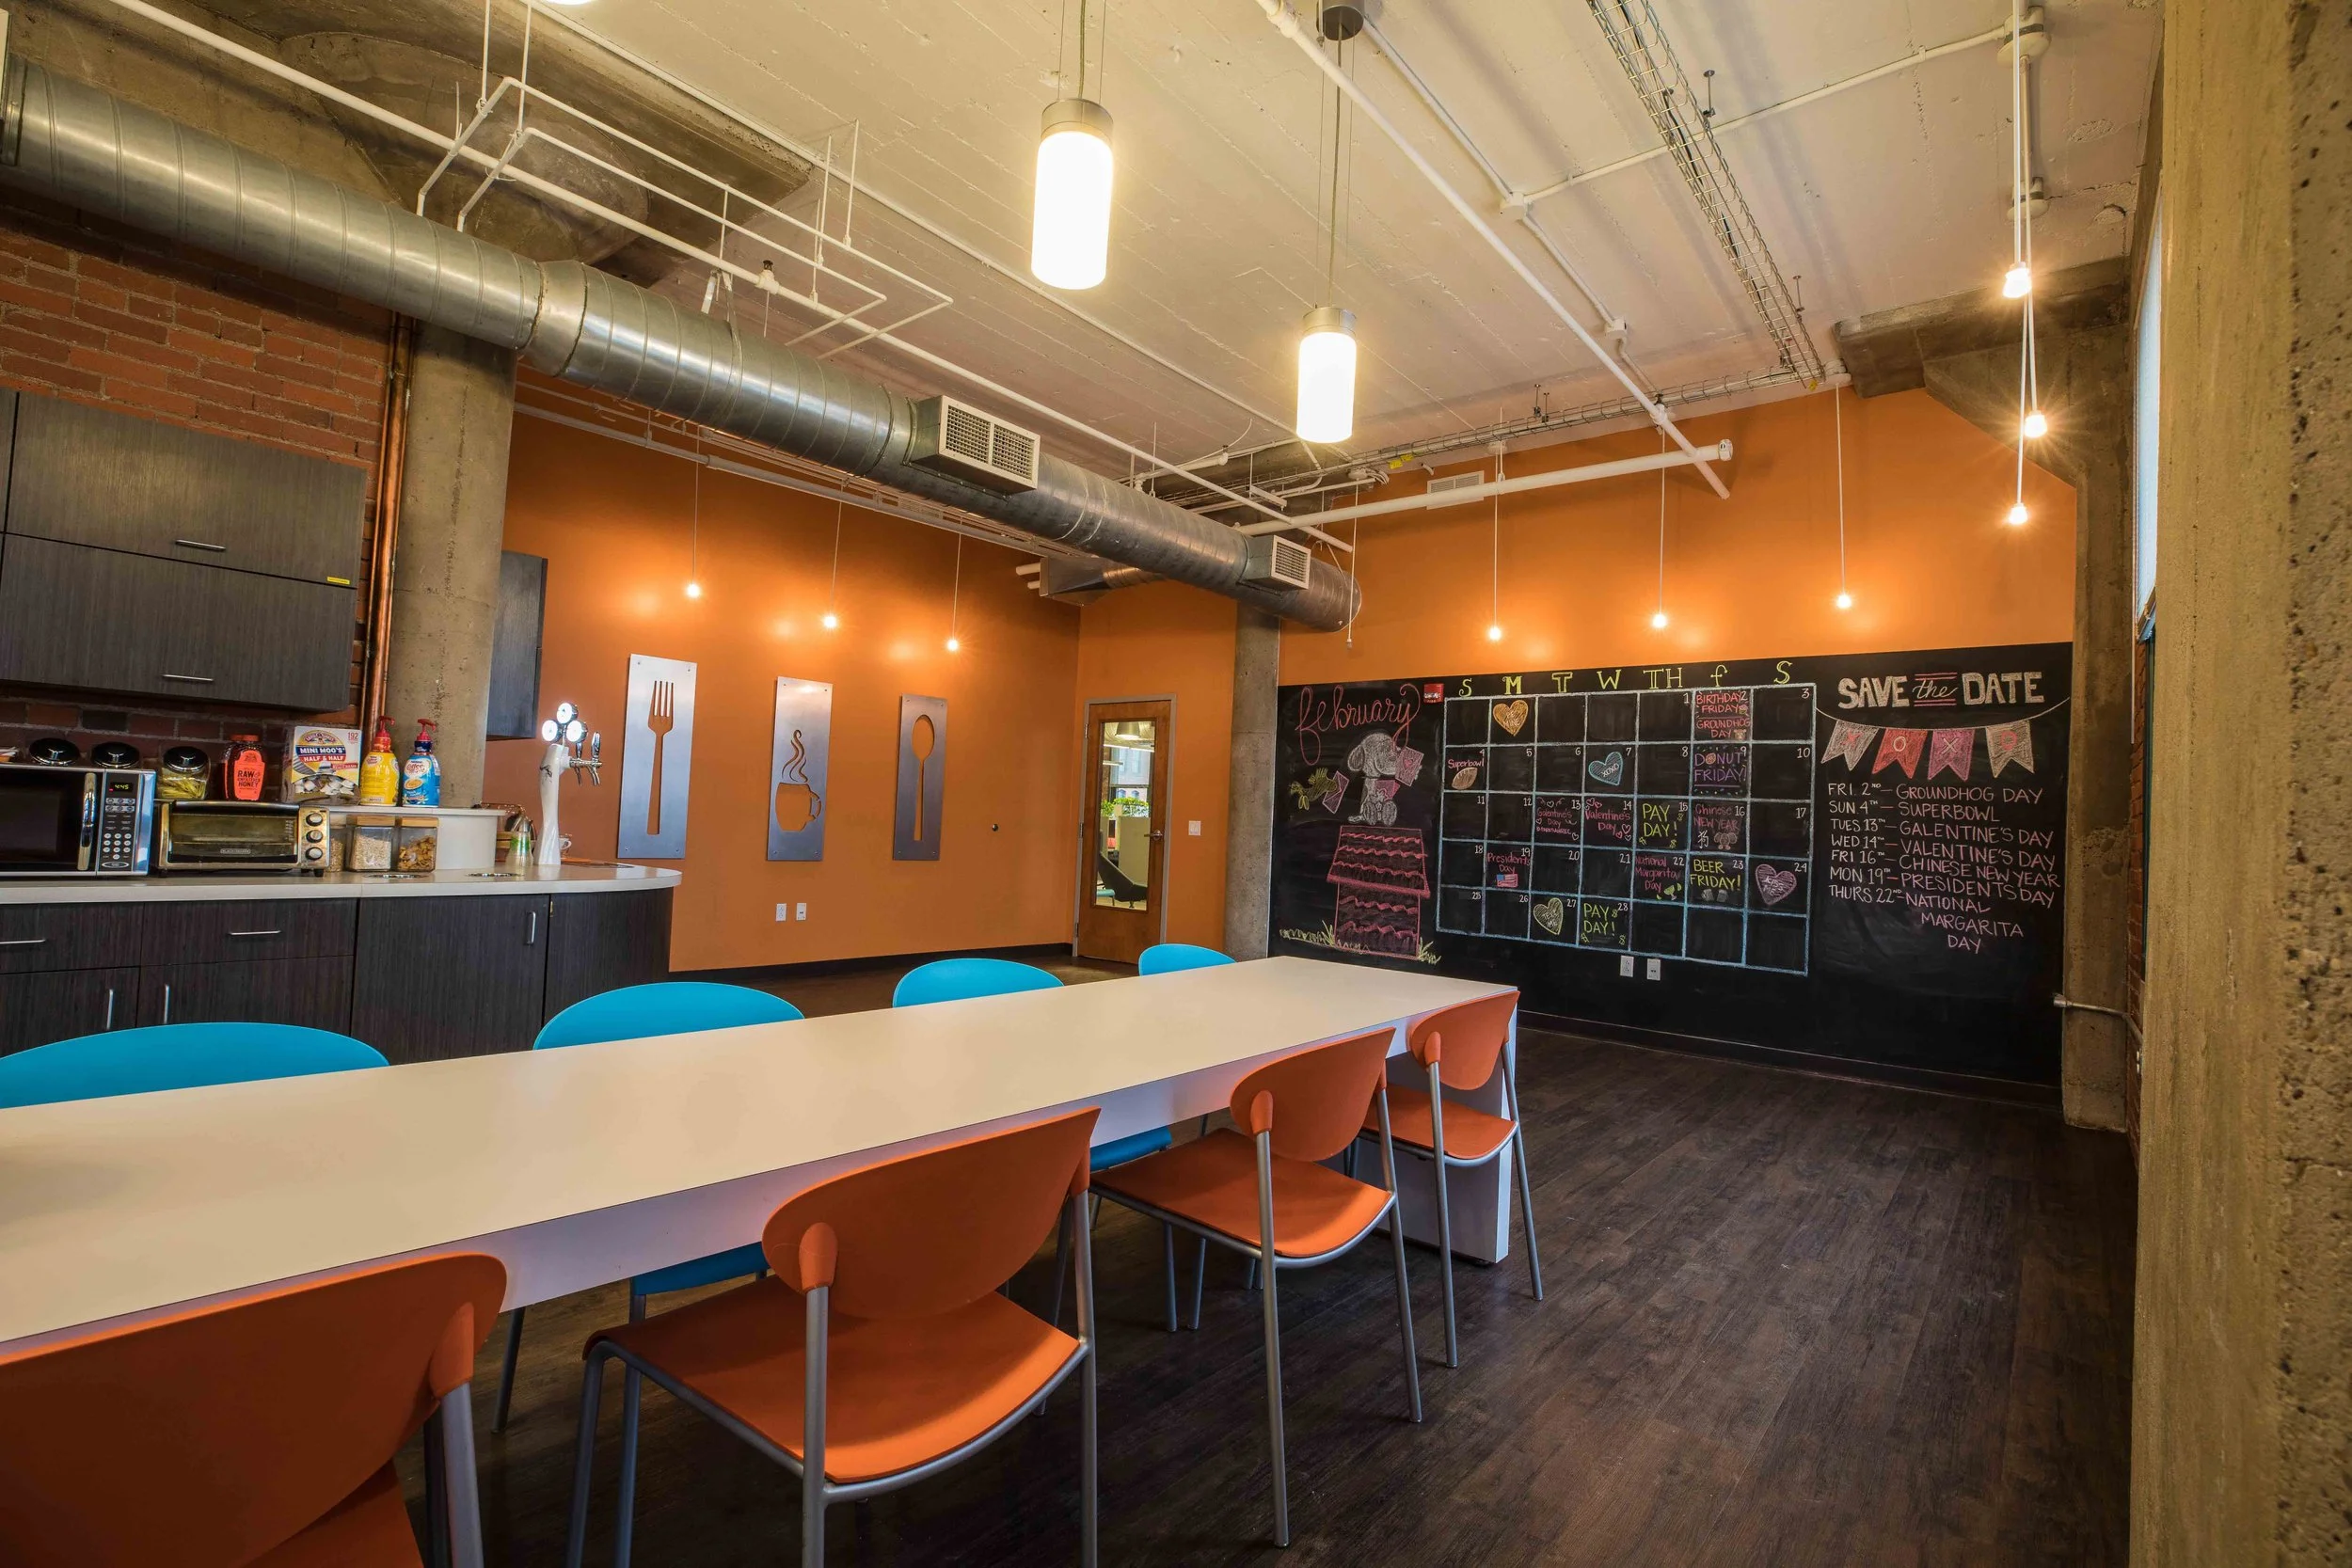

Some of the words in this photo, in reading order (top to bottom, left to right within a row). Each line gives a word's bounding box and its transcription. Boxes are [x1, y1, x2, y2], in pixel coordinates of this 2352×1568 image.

[1459, 678, 1472, 697] S
[1502, 675, 1523, 695] M
[1552, 672, 1573, 693] T
[1597, 669, 1622, 690] W
[1773, 660, 1793, 685] S
[1740, 690, 1747, 702] 2
[1801, 688, 1810, 699] 3
[1837, 675, 1910, 709] SAVE
[1912, 677, 1959, 699] the
[1962, 672, 2045, 705] DATE
[1683, 692, 1690, 705] 1
[1696, 692, 1741, 705] BIRTHDAY
[1701, 705, 1740, 713] FRIDAY
[1696, 718, 1751, 730] GROUNDHOG
[347, 732, 358, 741] 192
[1710, 729, 1732, 738] DAY
[1893, 736, 1907, 752] O
[1941, 737, 1959, 754] X
[1526, 748, 1533, 757] 5
[1575, 748, 1581, 756] 6
[1626, 747, 1632, 757] 7
[1681, 747, 1689, 757] 8
[1740, 746, 1747, 757] 9
[1796, 747, 1811, 758] 10
[1447, 757, 1485, 769] Superbowl
[1601, 763, 1619, 777] XOXO
[1694, 768, 1747, 782] FRIDAY!
[1476, 795, 1486, 805] 11
[1896, 784, 1994, 802] GROUNDHOG
[2003, 787, 2042, 804] DAY
[1523, 798, 1533, 807] 12
[1571, 800, 1581, 810] 13
[1623, 800, 1632, 811] 14
[1678, 801, 1689, 813] 15
[1585, 809, 1631, 821] Valentine's
[1643, 803, 1670, 822] PAY
[1695, 803, 1732, 816] Chinese
[1734, 805, 1745, 817] 16
[1795, 807, 1807, 819] 17
[1899, 801, 2000, 822] SUPERBOWL
[1548, 817, 1562, 828] Day
[1597, 822, 1616, 835] Day
[1693, 816, 1714, 828] NEW
[1714, 817, 1740, 832] YEAR
[1831, 818, 1860, 832] TUES
[1899, 820, 2014, 843] GALENTINE'S
[2019, 829, 2054, 849] DAY
[1474, 844, 1484, 854] 18
[1521, 847, 1531, 857] 19
[1568, 849, 1581, 861] 20
[1831, 834, 1860, 847] WED
[1900, 838, 2013, 864] VALENTINE'S
[2019, 850, 2056, 872] DAY
[1619, 853, 1631, 863] 21
[1635, 854, 1667, 867] National
[1673, 856, 1685, 866] 22
[1499, 864, 1516, 875] Day
[1693, 859, 1724, 874] BEER
[1732, 859, 1744, 870] 23
[1794, 862, 1807, 873] 24
[1831, 849, 1854, 863] FRI
[1899, 854, 1973, 877] CHINESE
[1977, 865, 2010, 882] NEW
[2015, 870, 2061, 888] YEAR
[1635, 866, 1680, 882] Margarita
[1645, 880, 1662, 894] Day
[1690, 874, 1740, 891] FRIDAY!
[1830, 866, 1863, 882] MON
[2021, 888, 2054, 909] DAY
[1471, 892, 1482, 900] 25
[1518, 895, 1529, 903] 26
[1828, 884, 1872, 903] THURS
[1905, 893, 1991, 913] NATIONAL
[1566, 898, 1577, 908] 27
[1617, 903, 1629, 911] 28
[1583, 903, 1609, 918] PAY
[1922, 912, 2024, 937] MARGARITA
[1947, 934, 1981, 954] DAY
